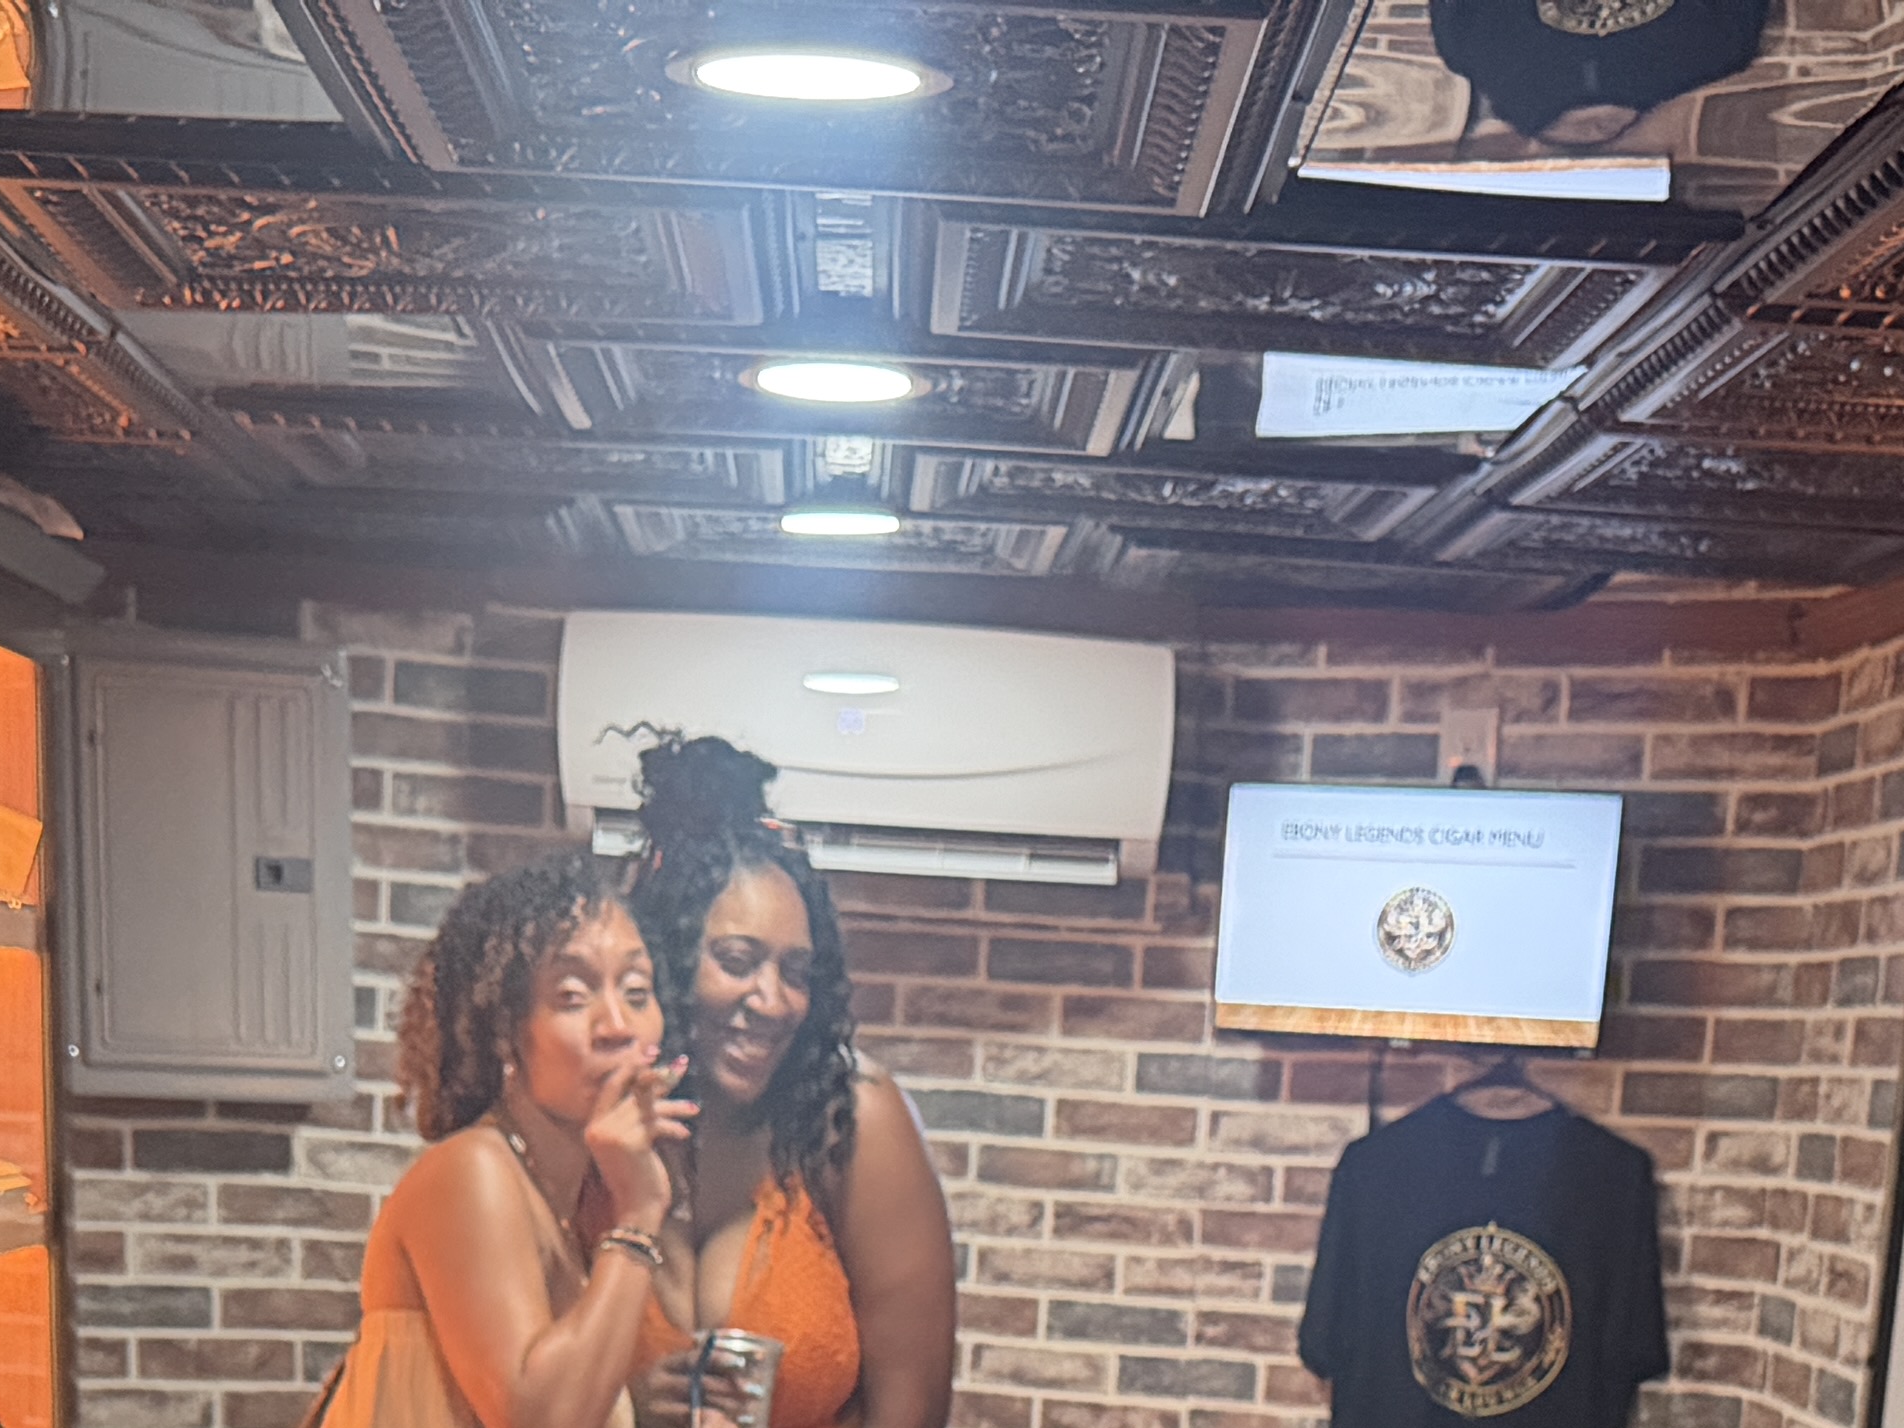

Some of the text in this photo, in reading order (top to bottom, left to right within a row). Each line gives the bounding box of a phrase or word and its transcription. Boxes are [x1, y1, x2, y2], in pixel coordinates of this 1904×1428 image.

[1345, 823, 1424, 845] LEGENDS
[1428, 827, 1483, 846] CIGAR
[1488, 830, 1545, 849] MENU
